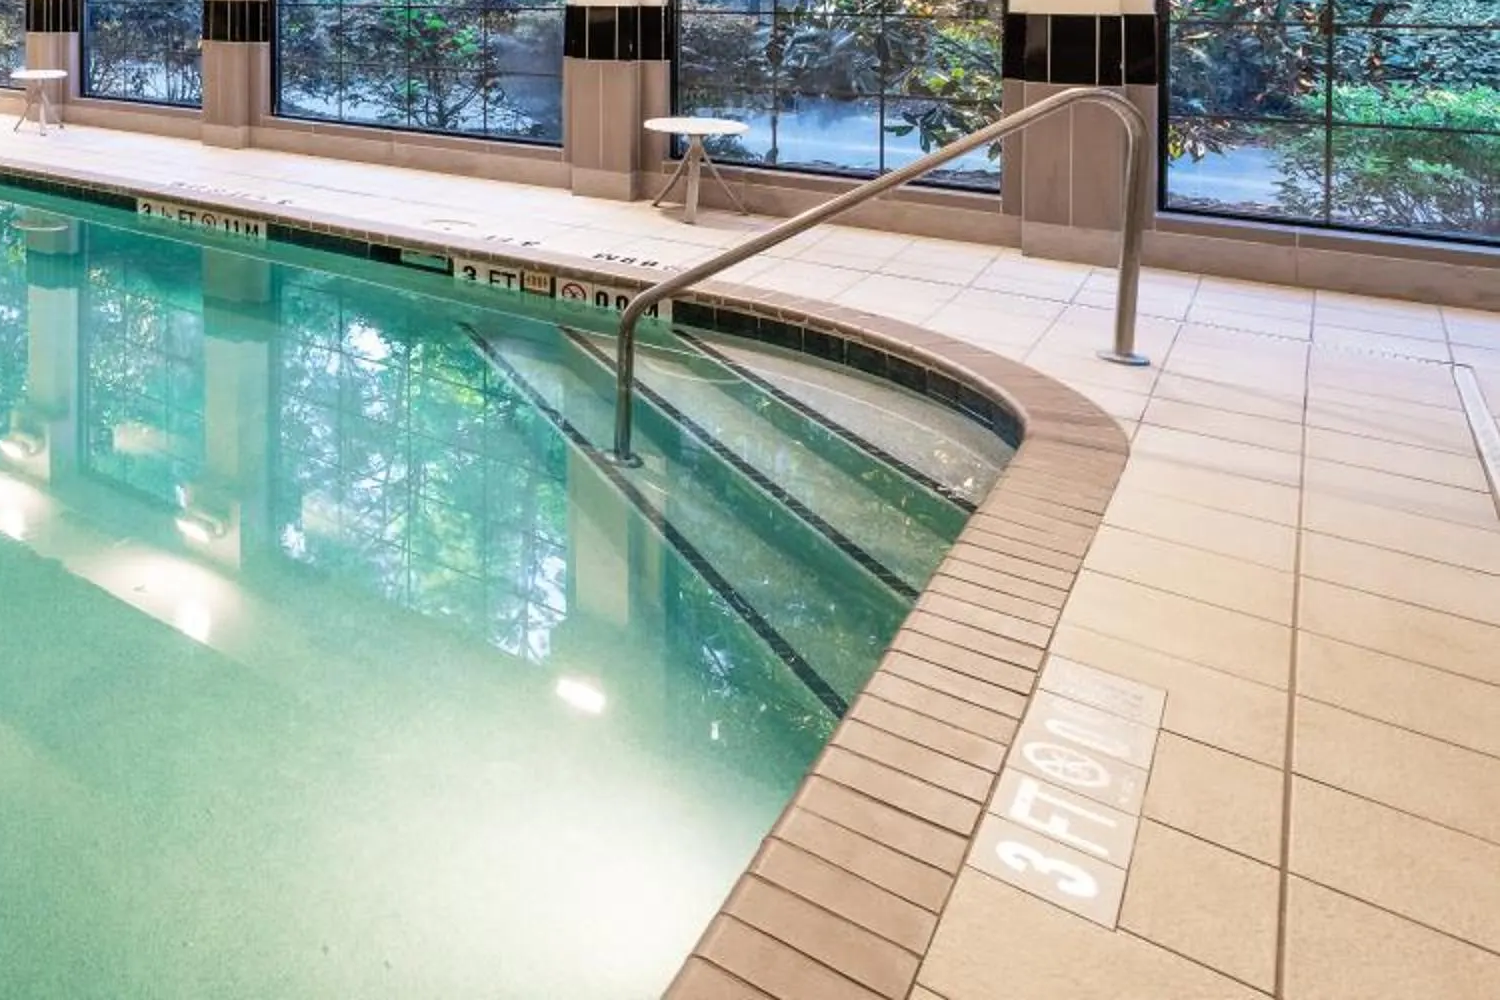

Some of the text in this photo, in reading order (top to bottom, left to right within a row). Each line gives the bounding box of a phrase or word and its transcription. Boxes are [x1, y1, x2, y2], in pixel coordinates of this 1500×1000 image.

[489, 269, 517, 290] FT
[1008, 778, 1119, 858] FT
[996, 840, 1100, 898] 3
